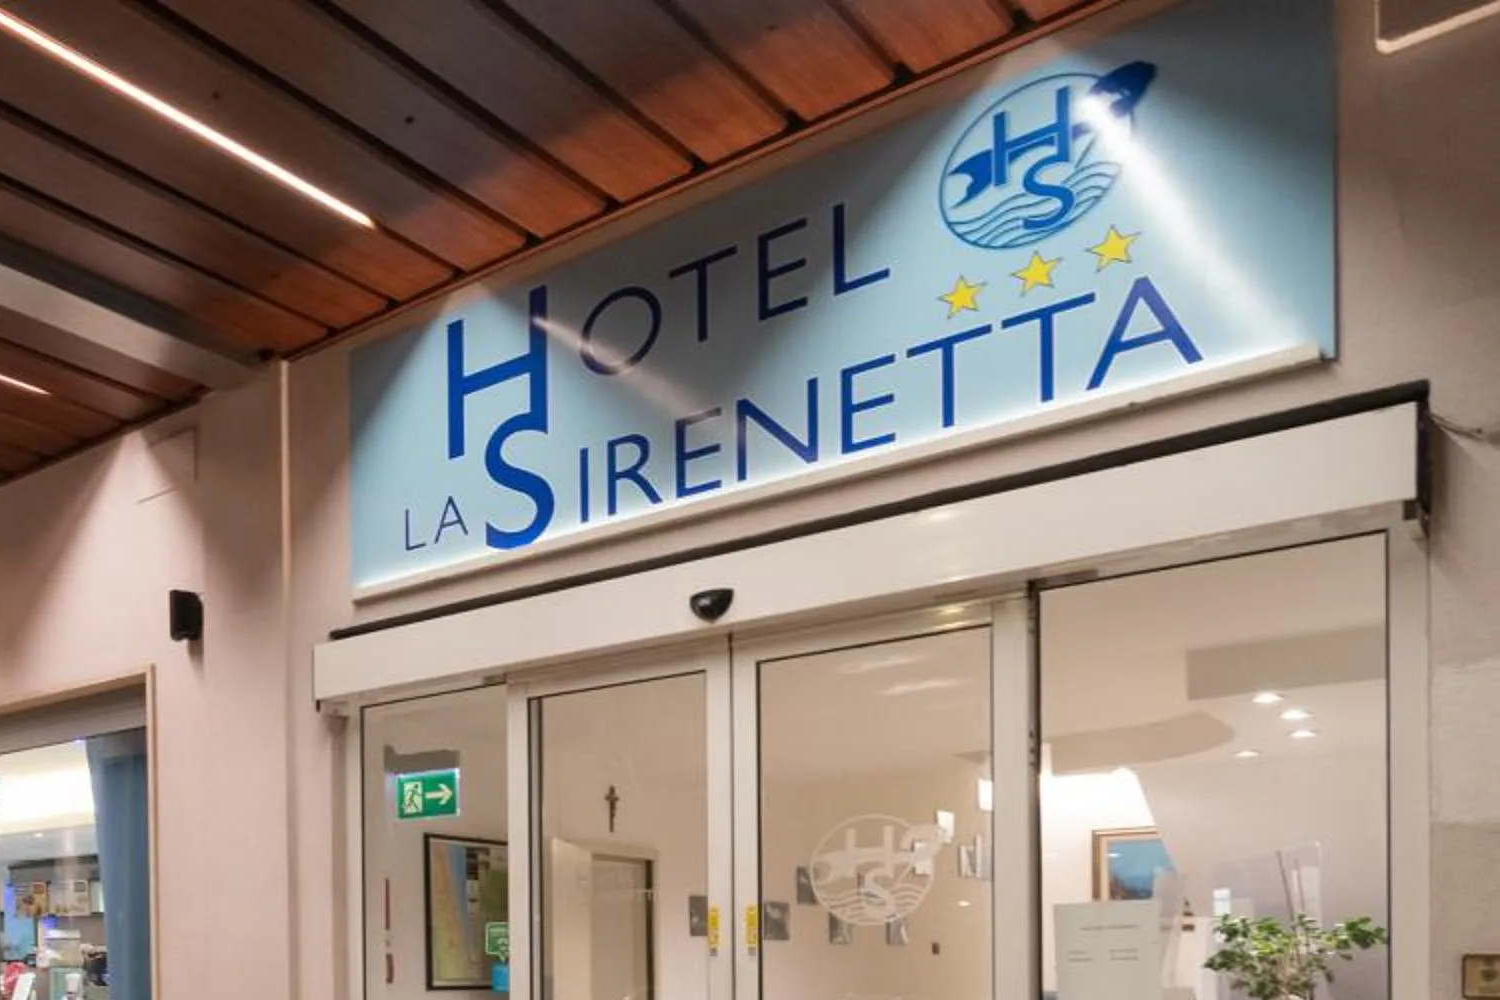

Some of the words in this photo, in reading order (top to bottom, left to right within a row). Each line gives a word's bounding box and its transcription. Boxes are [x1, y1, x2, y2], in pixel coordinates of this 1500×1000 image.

[403, 495, 469, 552] LA
[484, 276, 1205, 551] SIRENETTA
[446, 203, 892, 461] HOTEL
